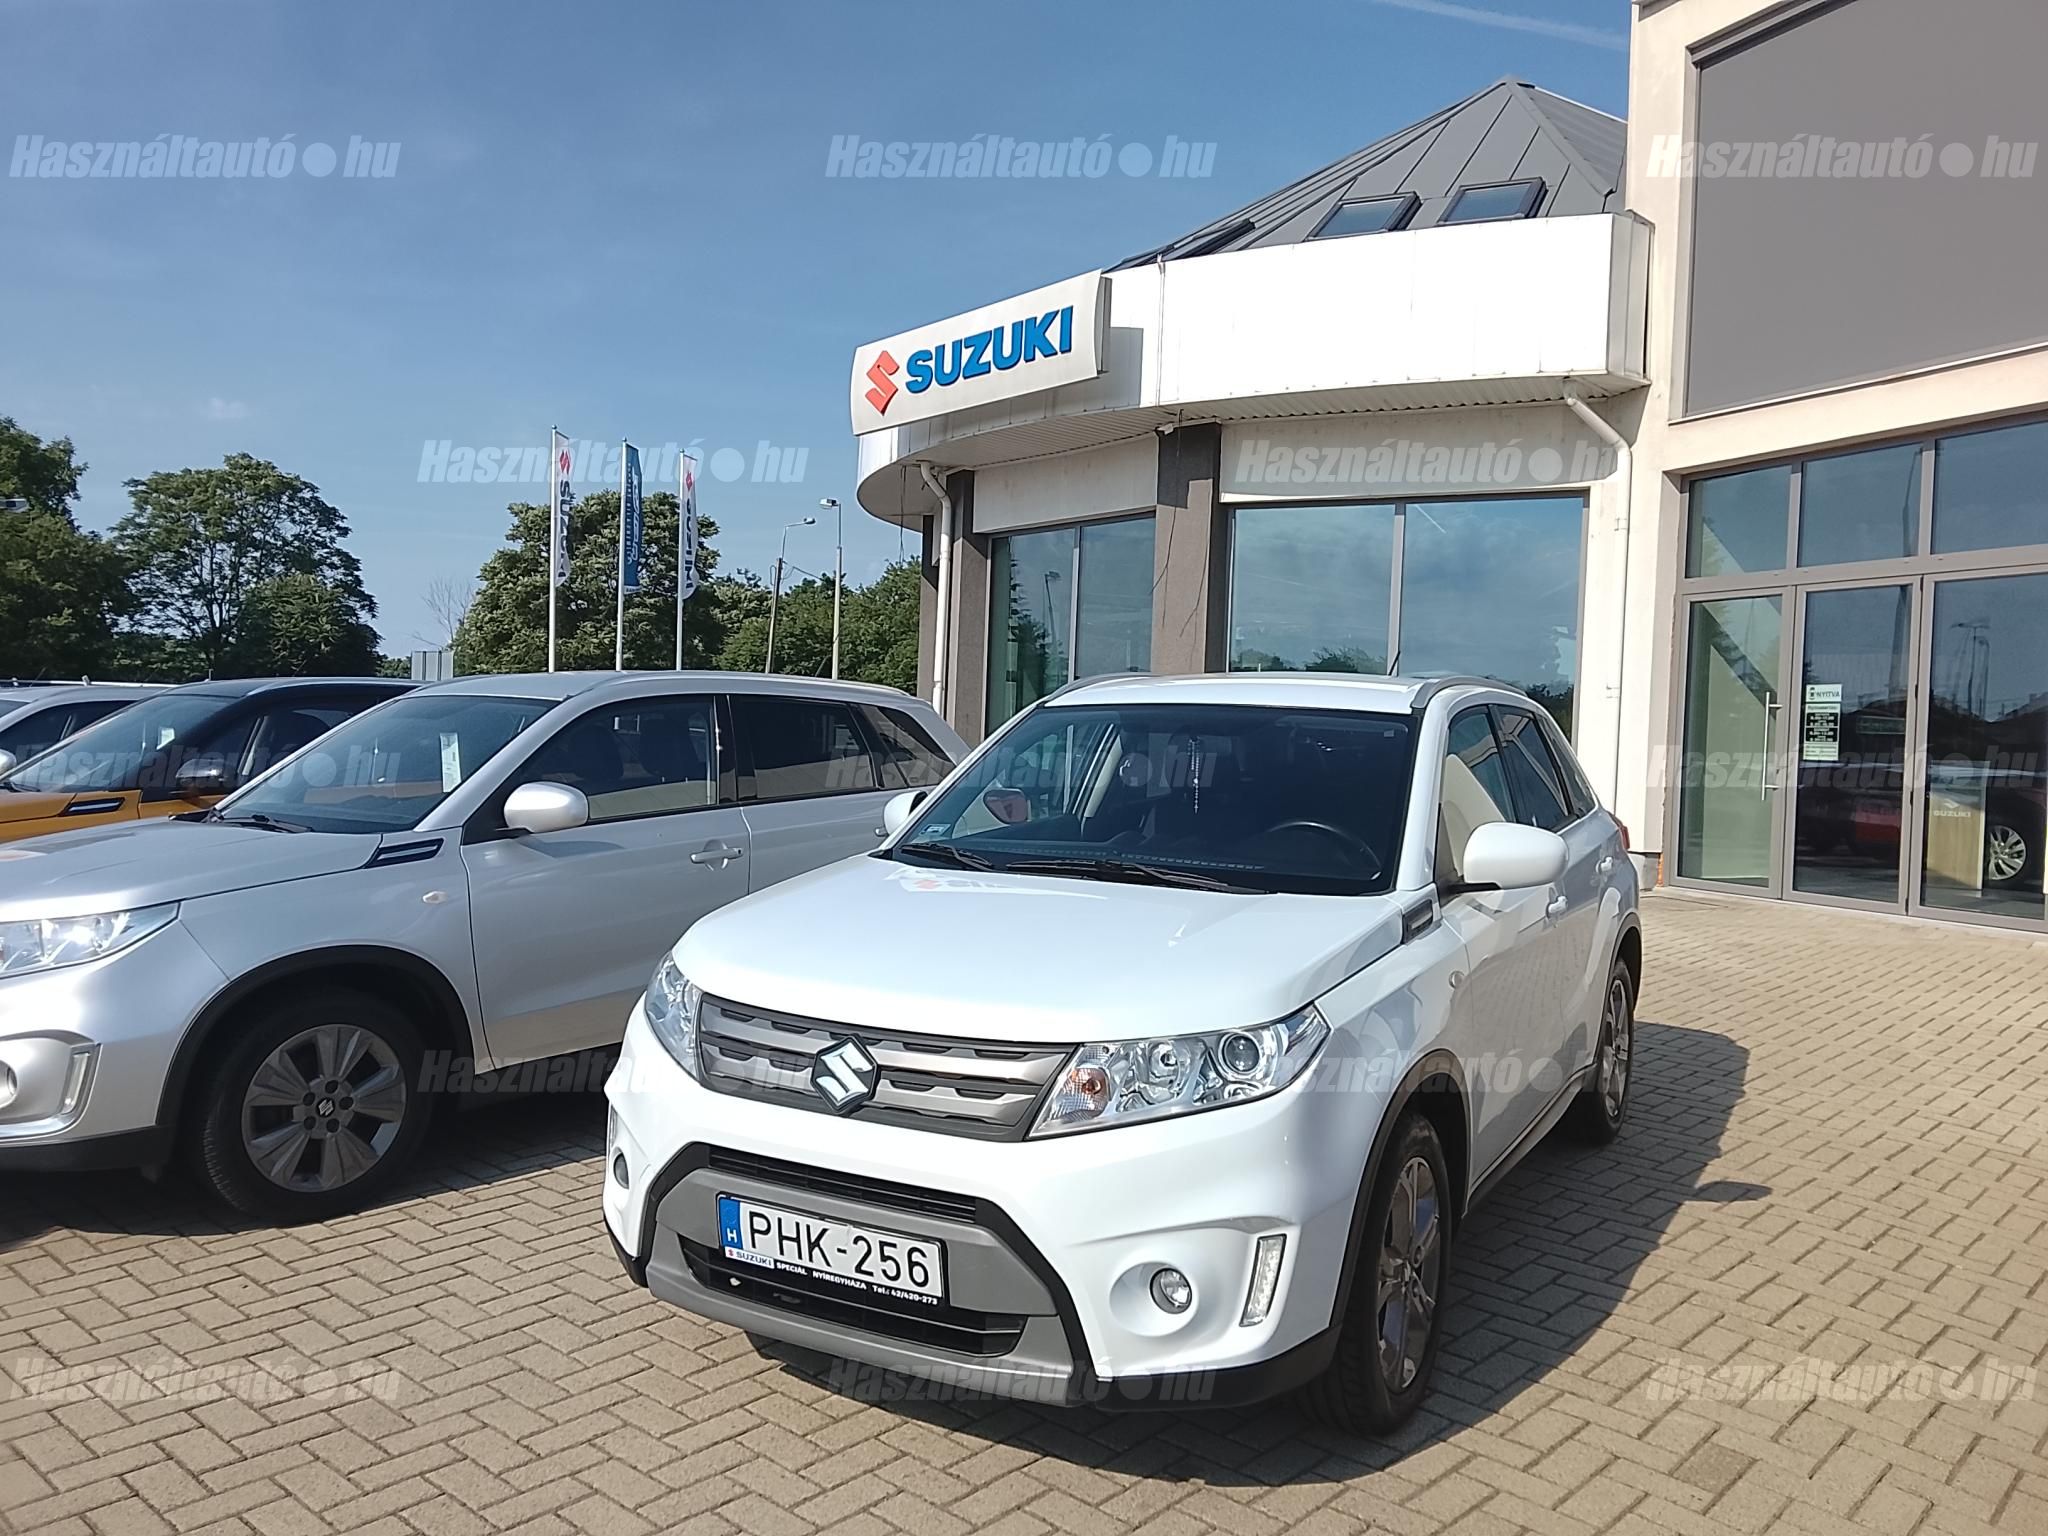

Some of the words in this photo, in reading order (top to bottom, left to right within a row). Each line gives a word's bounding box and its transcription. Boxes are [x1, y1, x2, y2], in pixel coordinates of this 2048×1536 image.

[905, 305, 1074, 394] SUZUKI
[558, 480, 571, 578] SUZI
[726, 1228, 738, 1243] H
[736, 1251, 772, 1267] SUZUKI
[776, 1262, 808, 1276] SPECIÁL
[812, 1271, 868, 1291] NYÍREGYHÁZA
[748, 1211, 930, 1288] PHK-256
